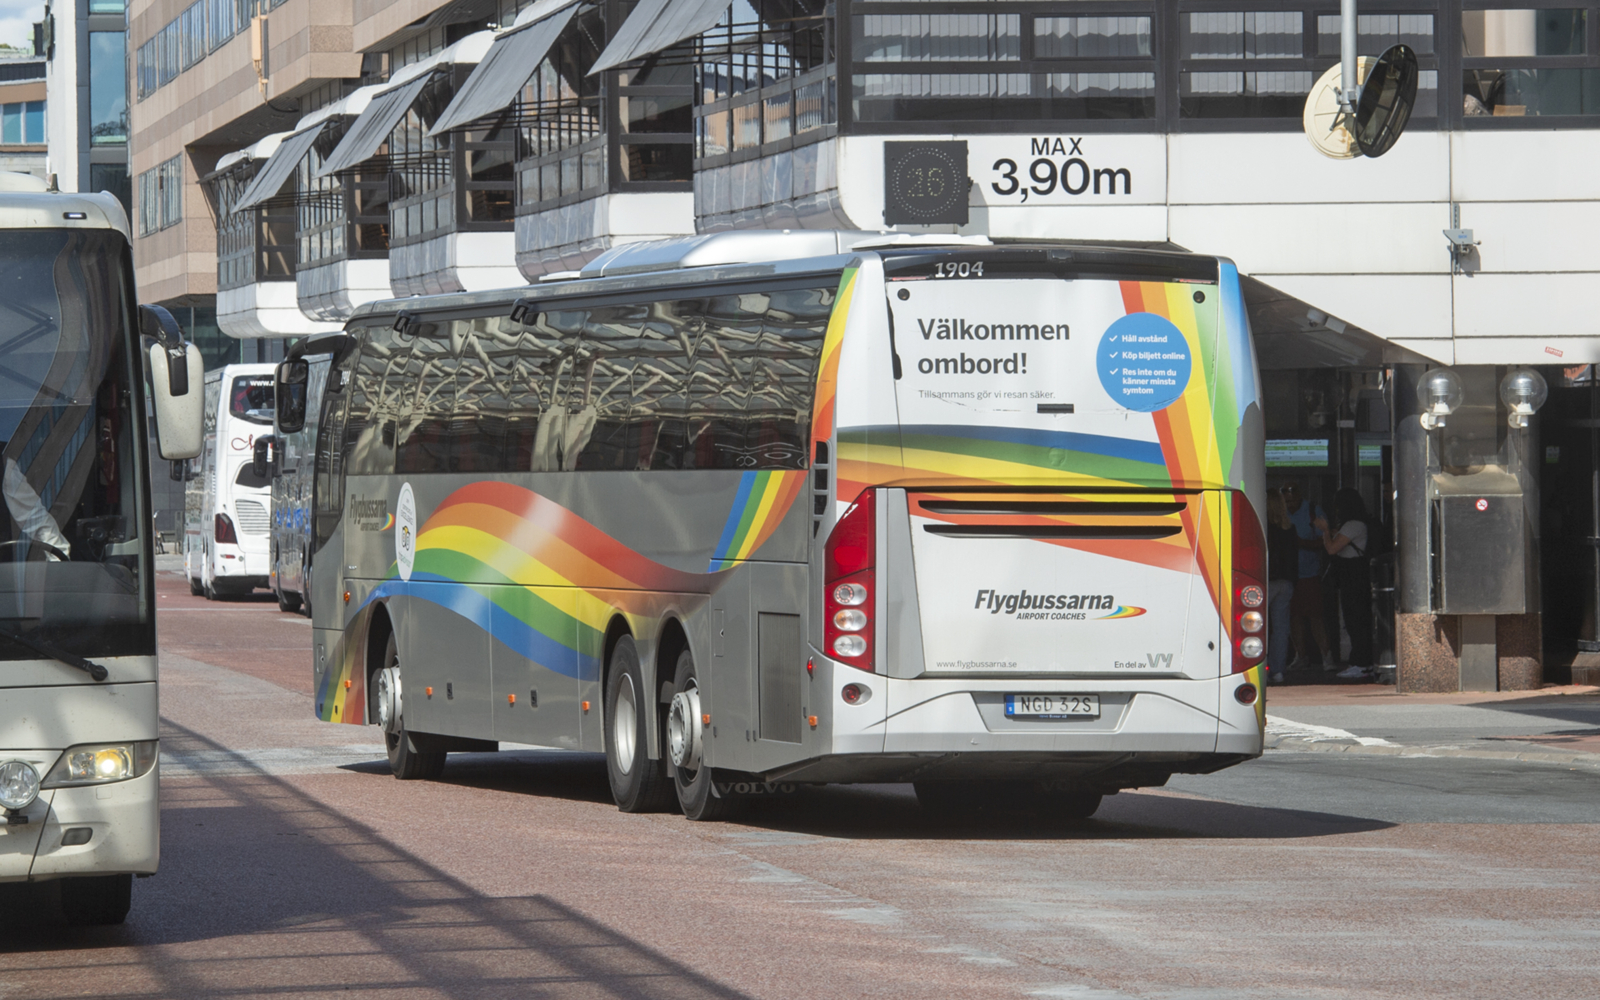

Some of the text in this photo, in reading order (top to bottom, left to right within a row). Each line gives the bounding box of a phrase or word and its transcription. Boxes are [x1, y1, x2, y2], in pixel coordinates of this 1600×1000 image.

[1030, 137, 1083, 156] MAX
[991, 157, 1132, 203] 3,90m
[934, 260, 985, 278] 1904
[917, 318, 1070, 341] Välkommen
[1121, 334, 1168, 343] Håll avstånd
[1122, 351, 1186, 361] Köp biljett online
[917, 352, 1027, 375] ombord!
[1122, 367, 1137, 376] Res
[1137, 368, 1152, 376] inte
[1166, 368, 1177, 376] du
[1122, 377, 1149, 385] känner
[918, 389, 1056, 400] Tillsammans gör vi resan säker.
[1122, 386, 1154, 396] symtom
[974, 589, 1115, 614] Flygbussarna
[1016, 612, 1087, 621] AIRPORT COACHES
[936, 660, 1018, 670] www.flygbussarna.se
[1114, 661, 1124, 669] En
[1125, 661, 1137, 669] del
[1020, 696, 1053, 712] NGD
[717, 781, 797, 795] VOLVO
